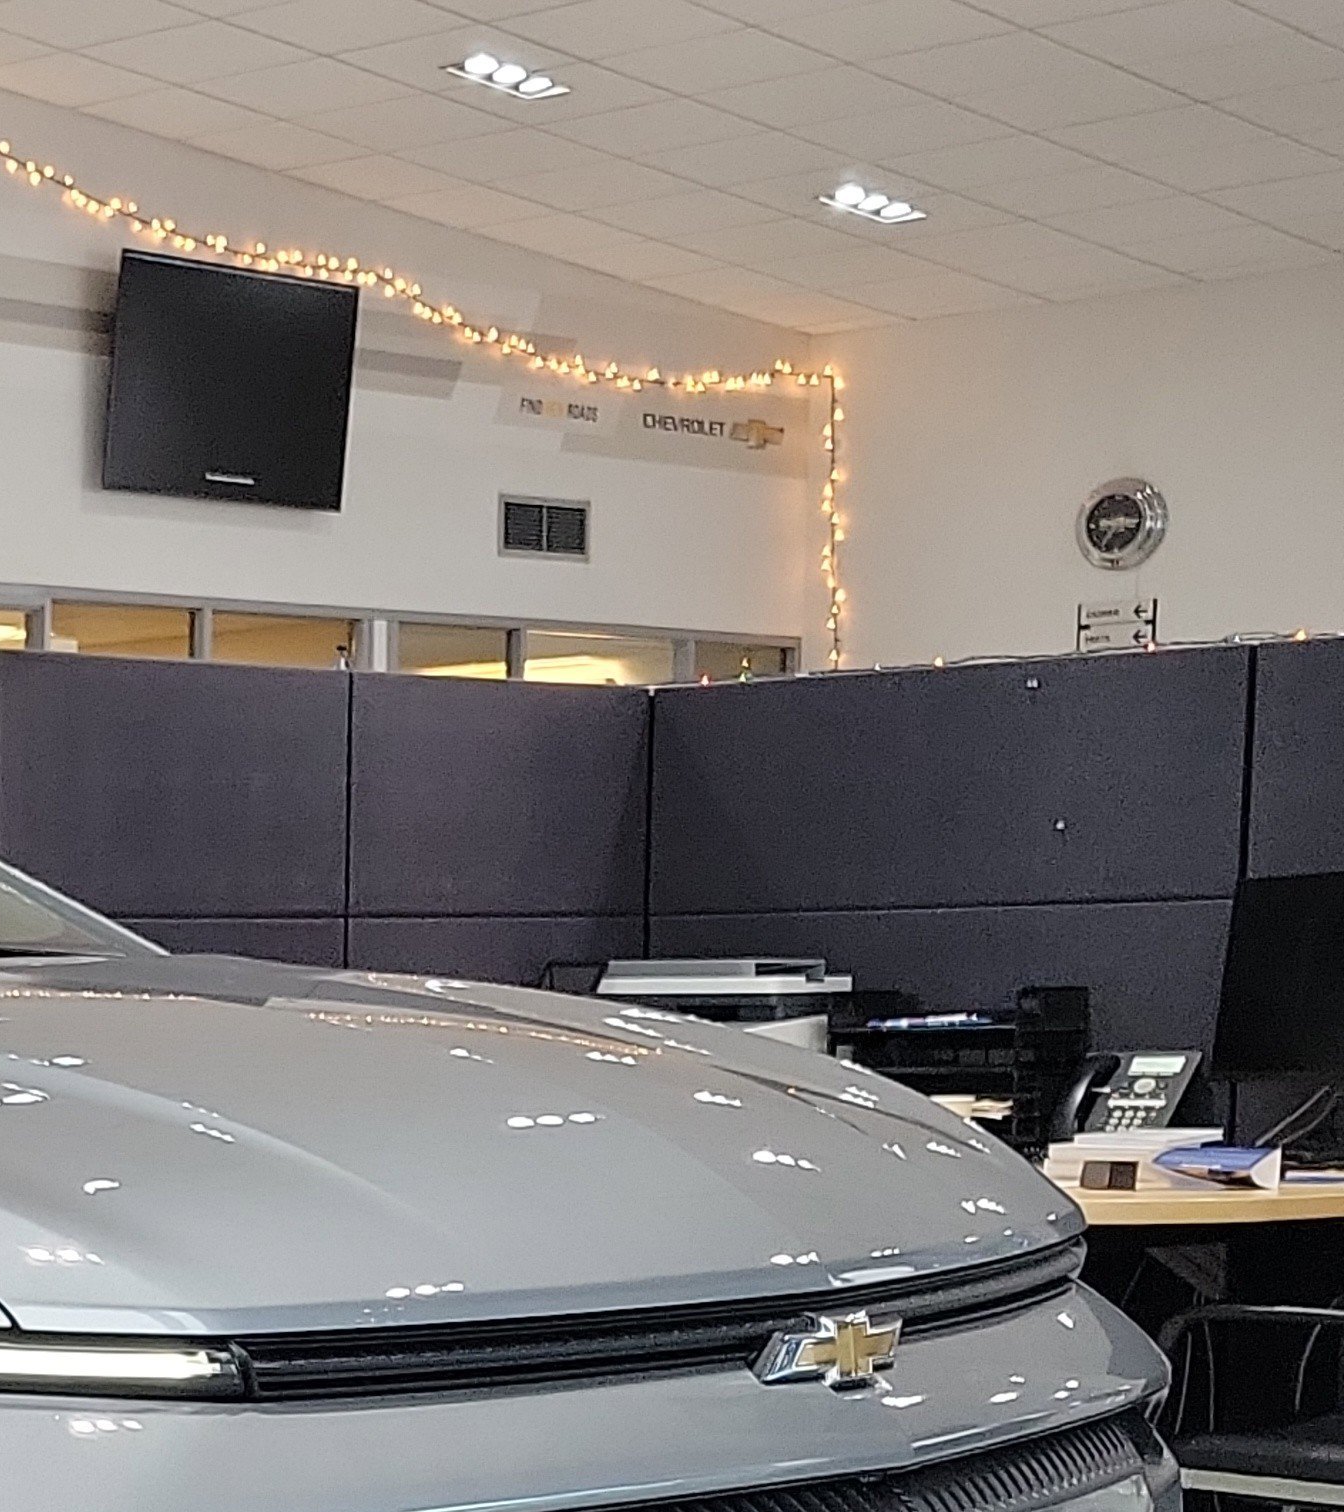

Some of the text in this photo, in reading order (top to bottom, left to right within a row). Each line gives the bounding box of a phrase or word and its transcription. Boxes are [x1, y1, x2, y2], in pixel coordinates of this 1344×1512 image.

[520, 396, 544, 415] FIND
[567, 403, 599, 423] ROADS
[643, 412, 725, 437] CHEVROLET
